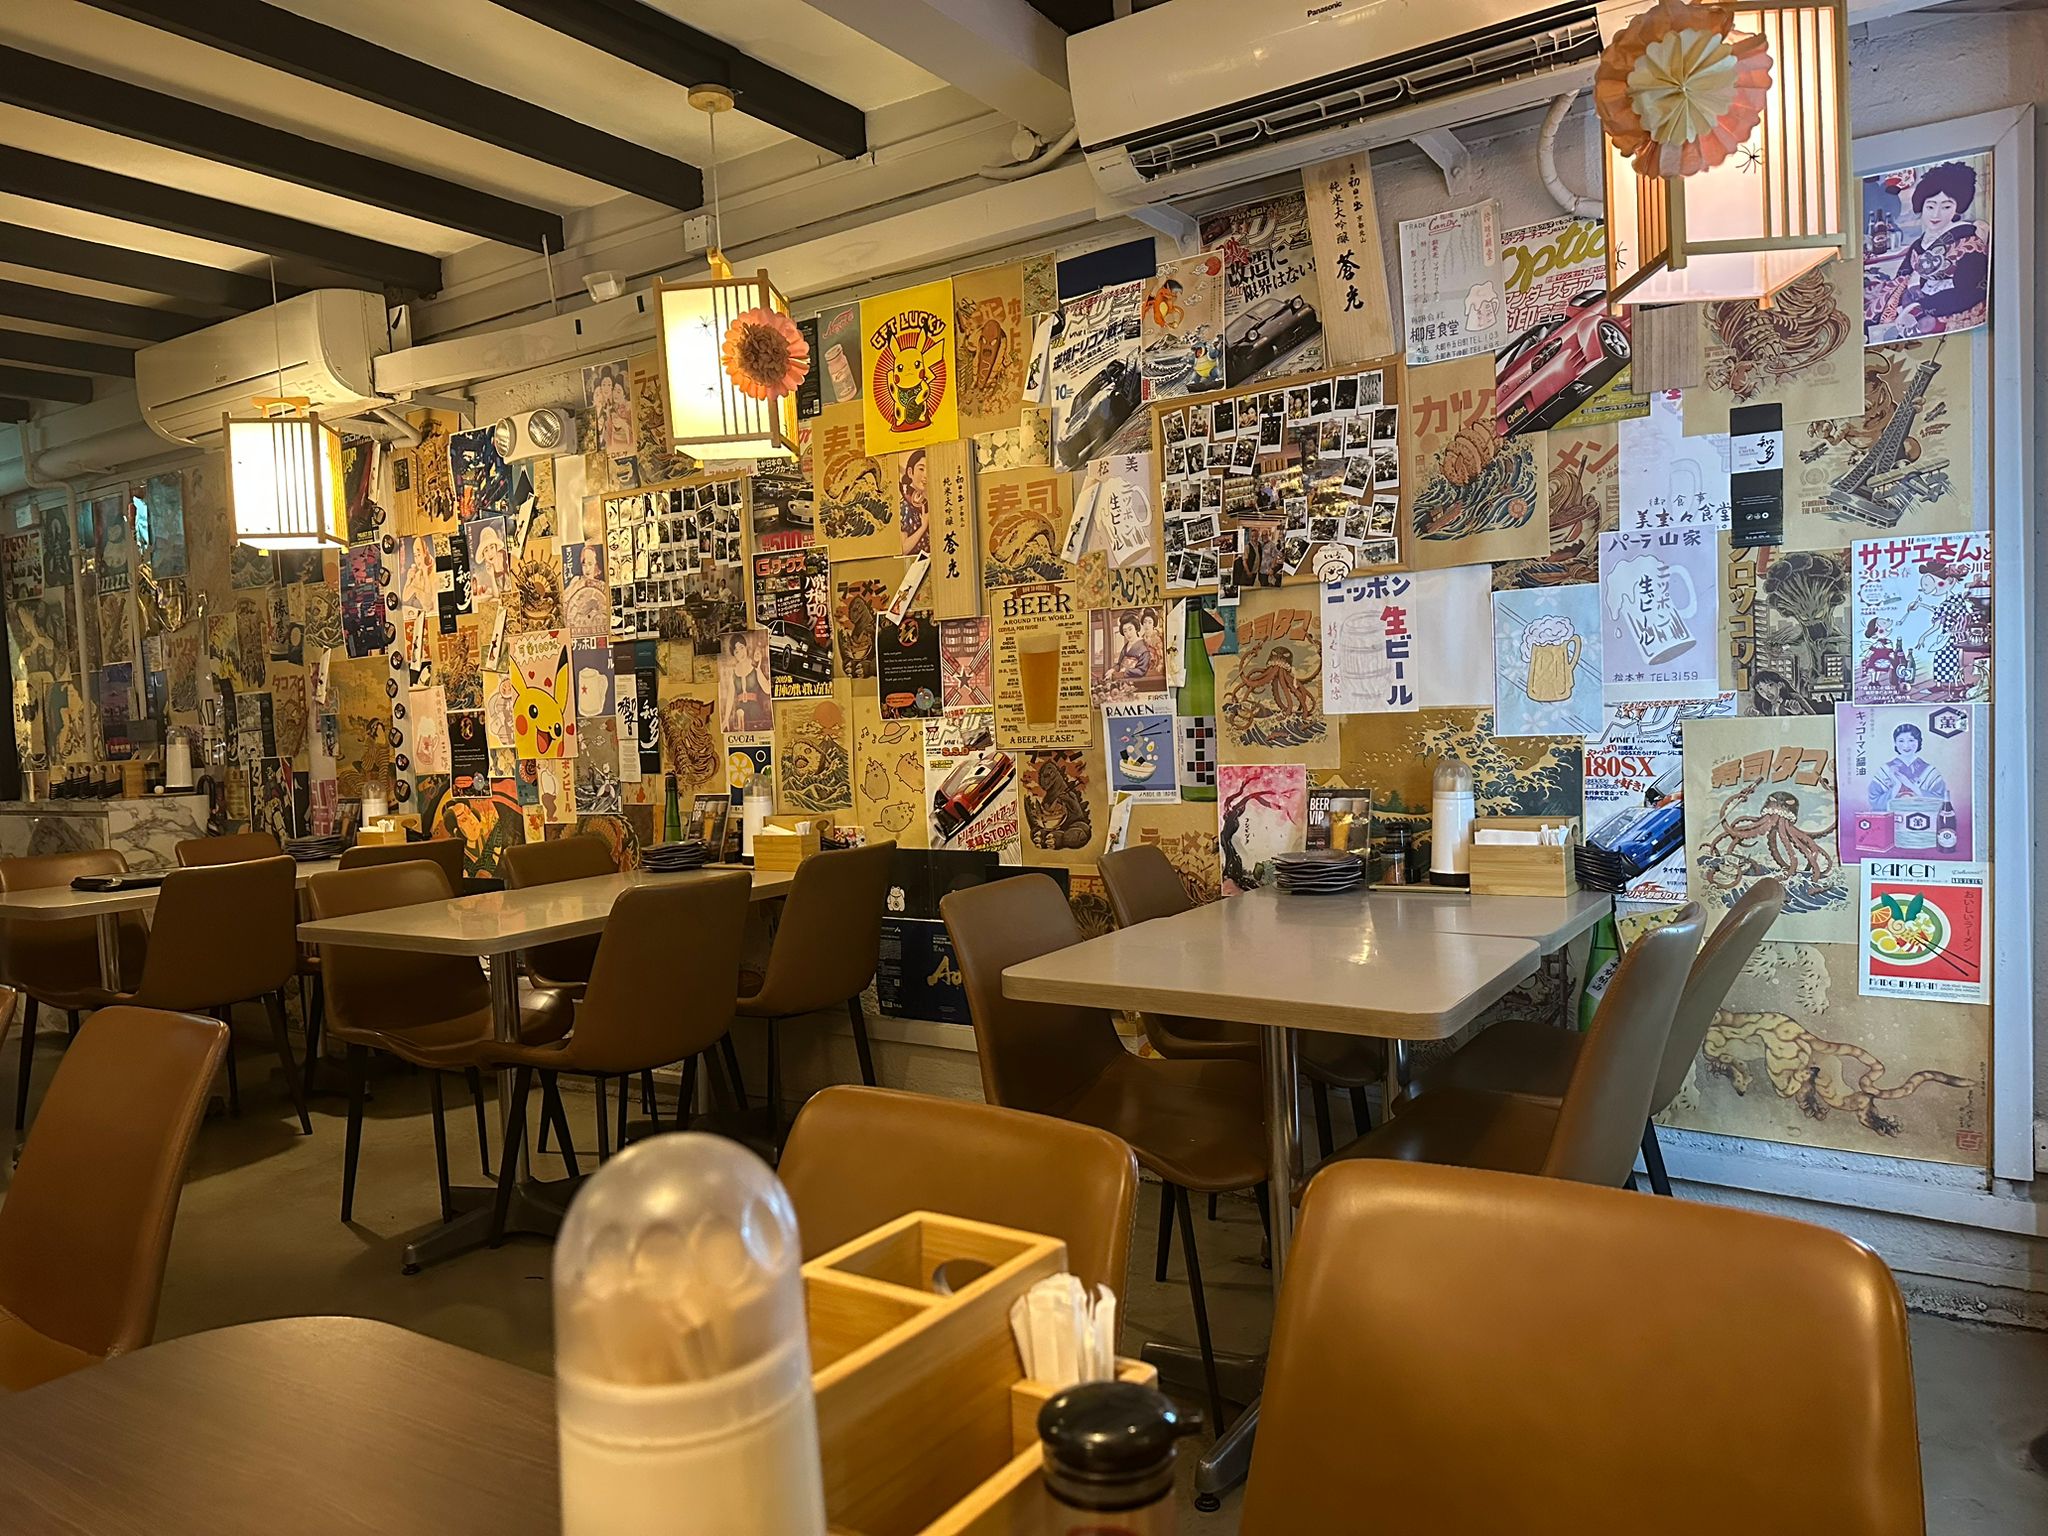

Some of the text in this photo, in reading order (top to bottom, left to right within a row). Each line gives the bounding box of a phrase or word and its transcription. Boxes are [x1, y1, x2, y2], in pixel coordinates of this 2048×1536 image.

[1307, 1, 1342, 17] Panasonic
[870, 317, 897, 350] GET
[900, 310, 947, 337] LUCKY
[1410, 320, 1460, 344] 柳屋食堂
[1411, 388, 1499, 438] カツ
[1506, 407, 1527, 424] Option
[1109, 492, 1125, 551] 生ビール
[1327, 575, 1411, 604] ニッポン
[1656, 564, 1671, 629] ニッポン
[1002, 593, 1074, 618] BEER
[1638, 573, 1655, 647] 生ビール
[1048, 613, 1075, 621] WORLD
[1380, 605, 1413, 706] 生ビール
[1105, 704, 1155, 717] RAMEN
[727, 735, 755, 744] GYOZA
[1010, 734, 1075, 744] A BEER, PLEASE!
[1584, 756, 1657, 778] 180SX
[1309, 797, 1330, 811] BEER
[1309, 810, 1324, 826] VIP
[1870, 863, 1936, 878] RAMEN
